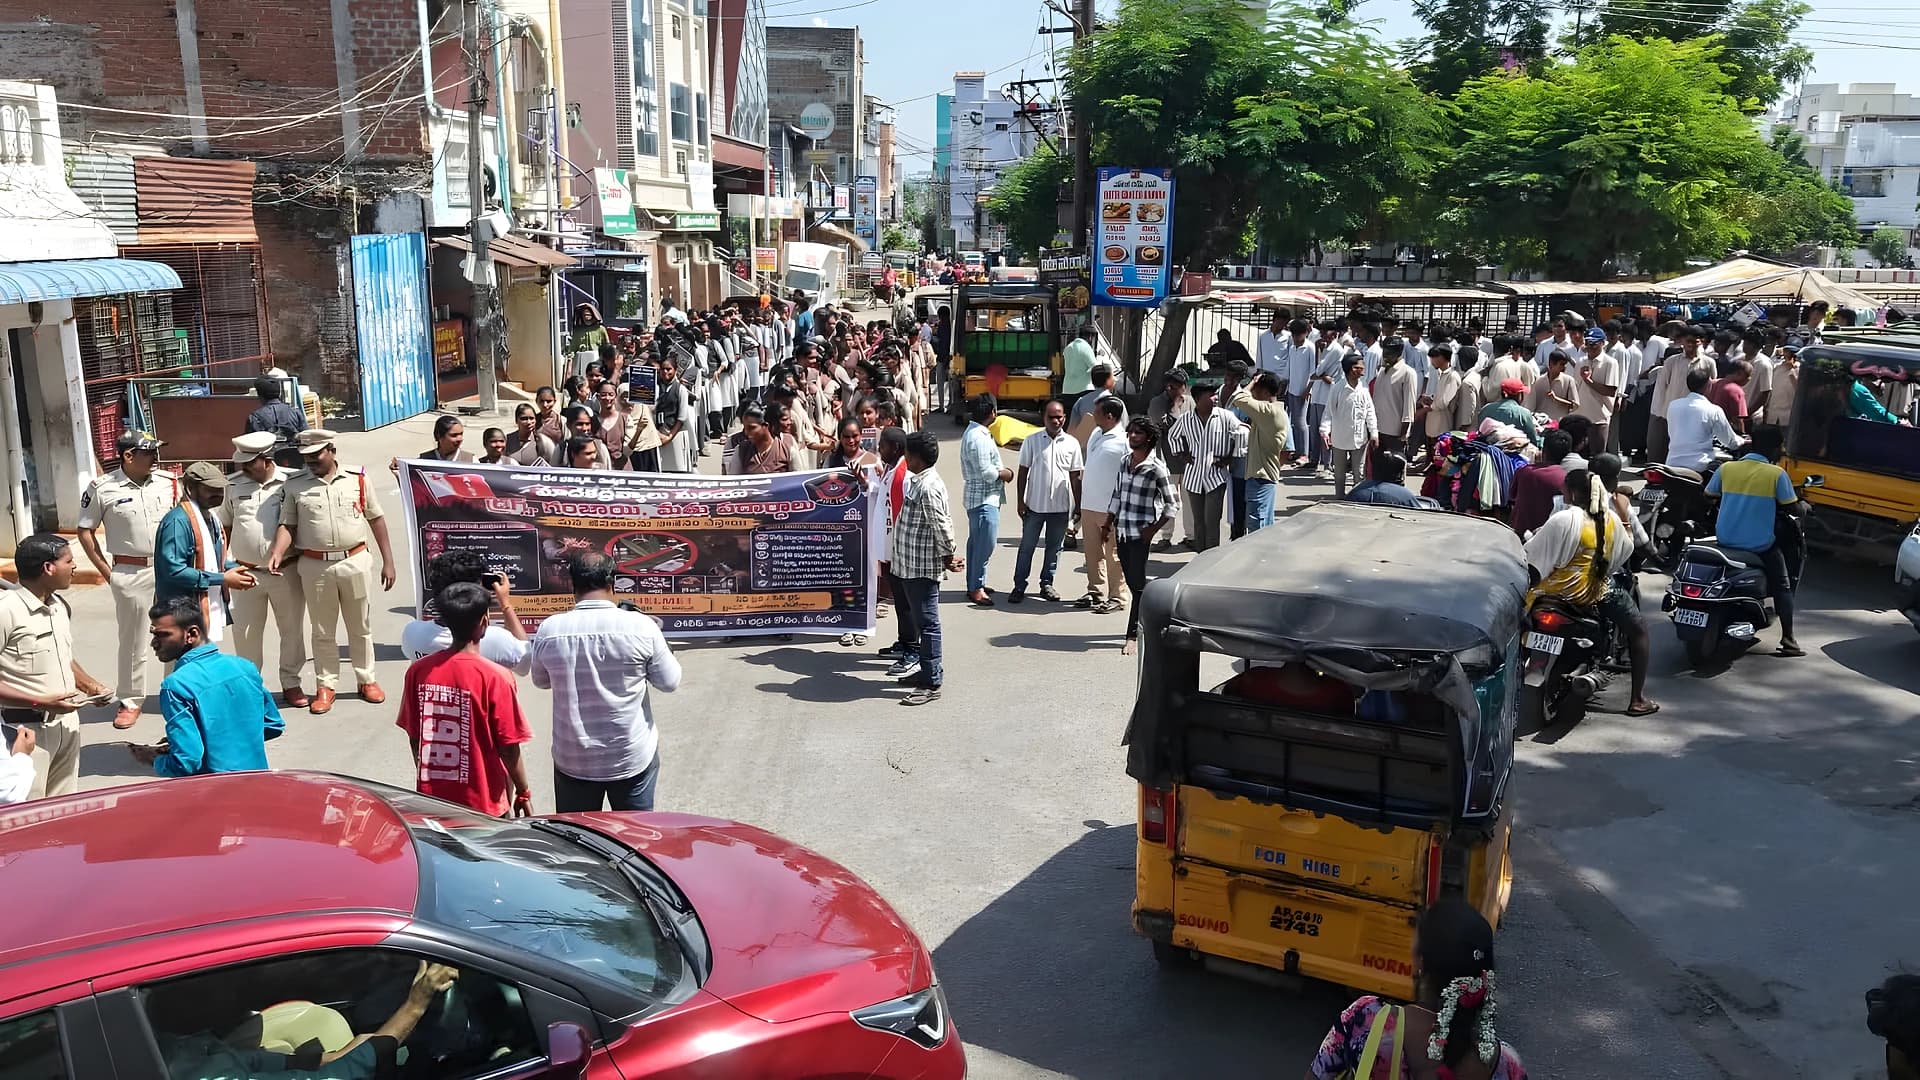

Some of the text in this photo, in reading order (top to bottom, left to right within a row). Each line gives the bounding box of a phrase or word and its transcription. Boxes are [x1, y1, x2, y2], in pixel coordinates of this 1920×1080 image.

[1255, 846, 1342, 879] FOR HIRE
[1178, 913, 1230, 935] SOUND
[1362, 954, 1412, 977] HORN
